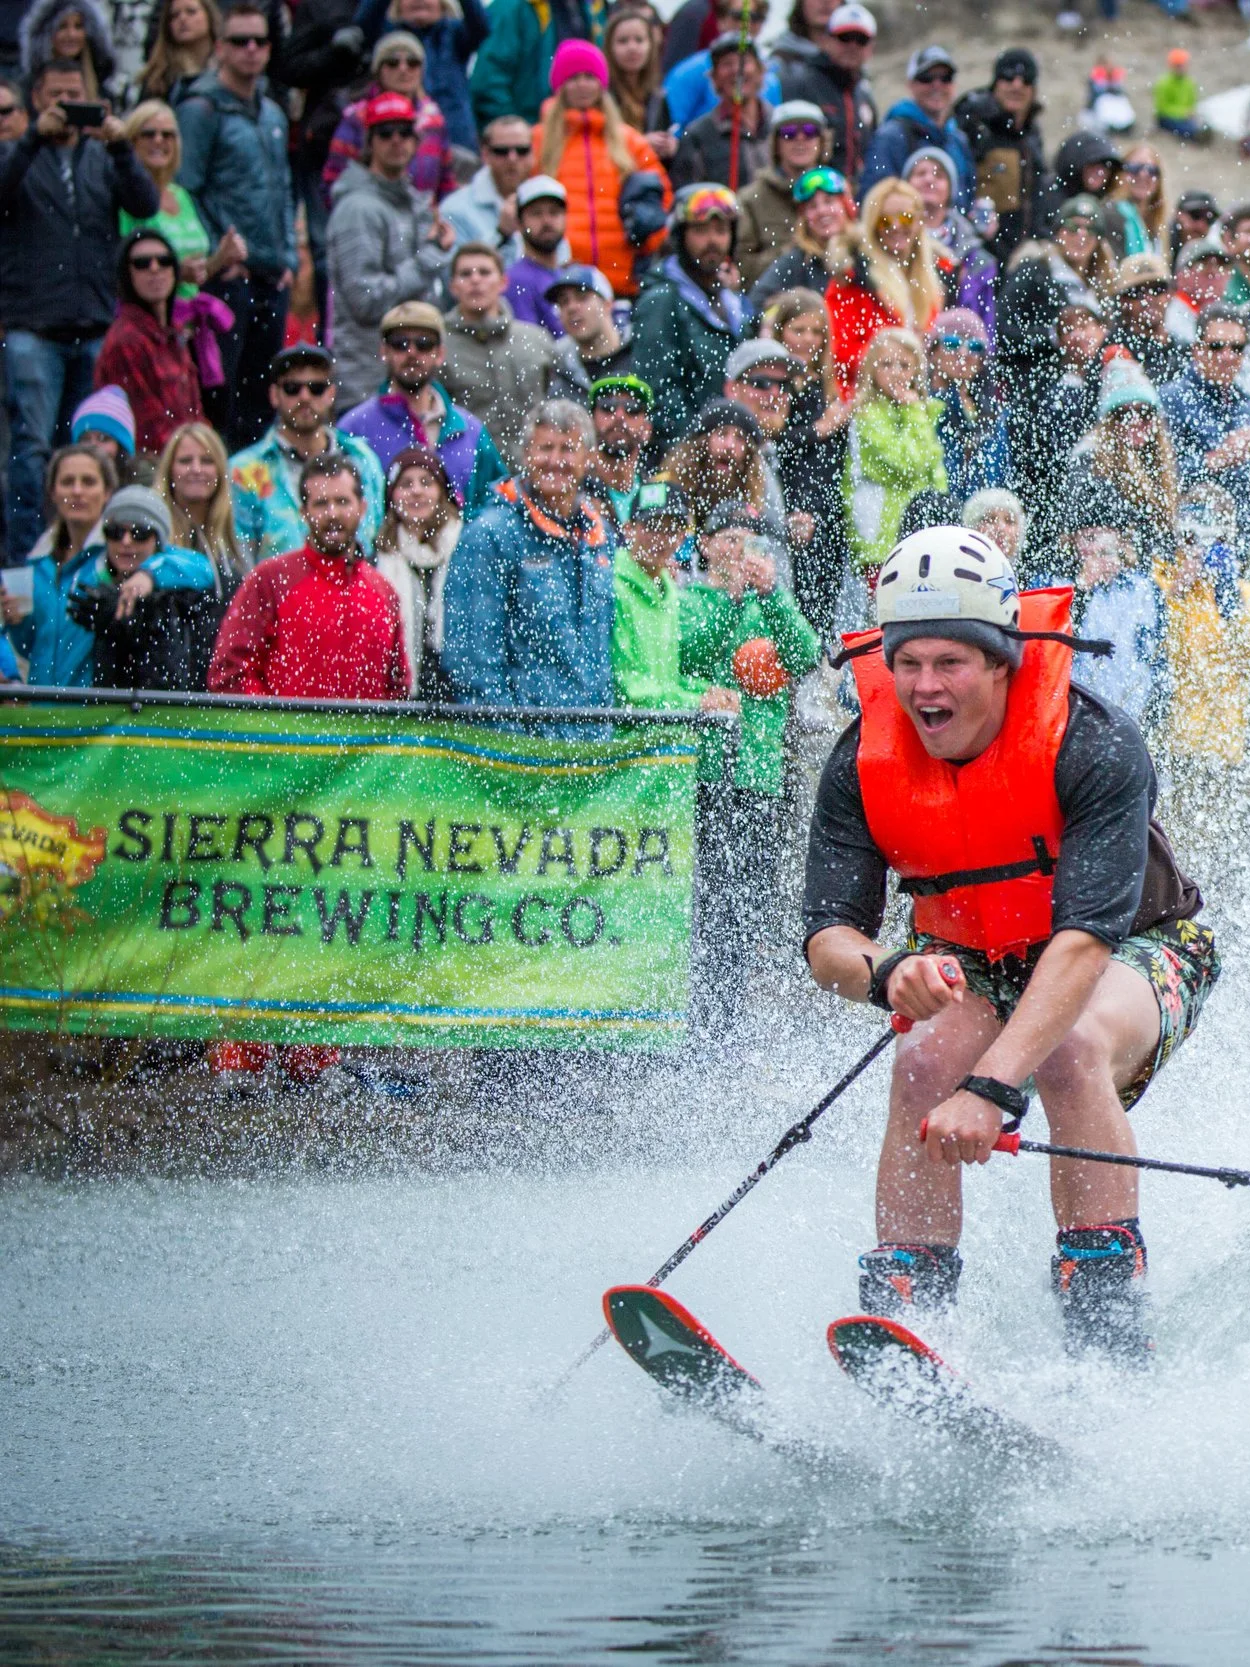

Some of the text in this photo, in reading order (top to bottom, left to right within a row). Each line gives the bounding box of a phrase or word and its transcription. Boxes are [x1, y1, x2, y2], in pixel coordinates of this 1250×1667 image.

[113, 807, 673, 881] SIERRA NEVADA
[158, 876, 621, 952] BREWING CO.
